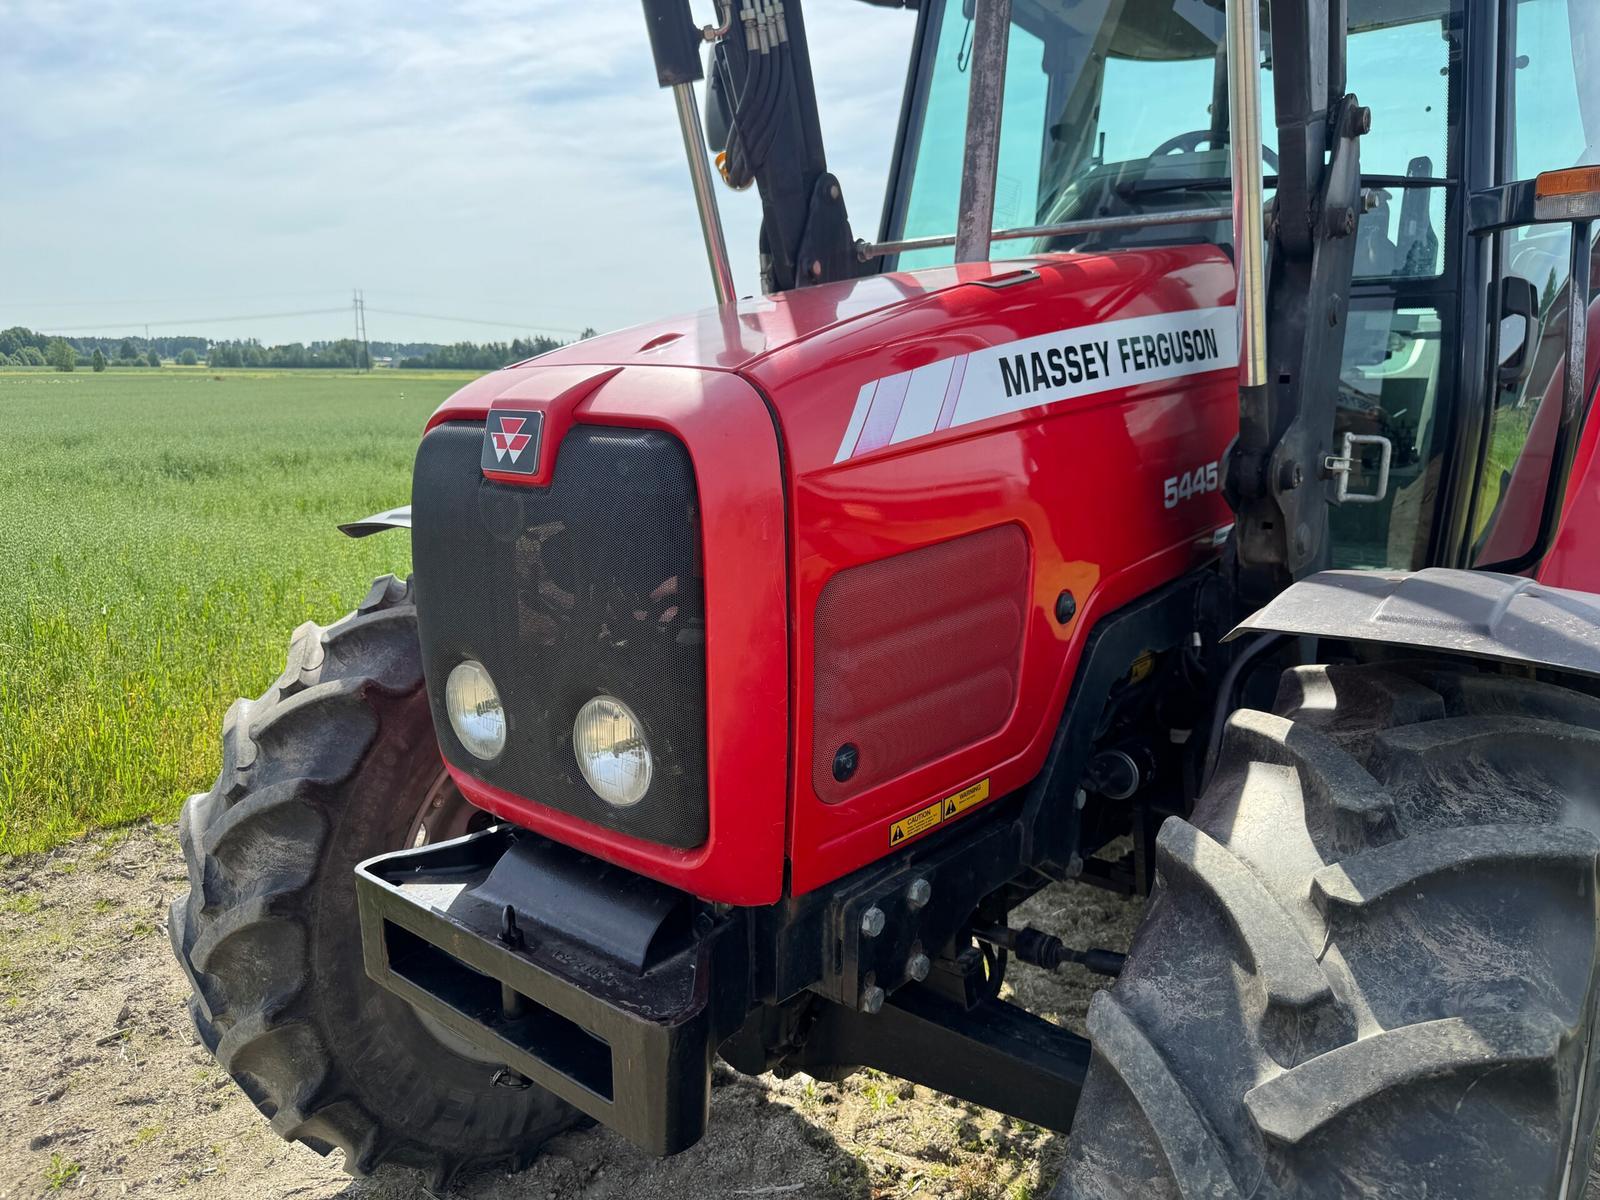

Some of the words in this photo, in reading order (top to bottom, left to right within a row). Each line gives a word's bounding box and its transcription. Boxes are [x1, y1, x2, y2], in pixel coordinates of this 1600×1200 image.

[998, 340, 1110, 397] MASSEY
[1118, 328, 1219, 374] FERGUSON
[1164, 461, 1218, 509] 5445
[907, 809, 931, 826] CAUTION
